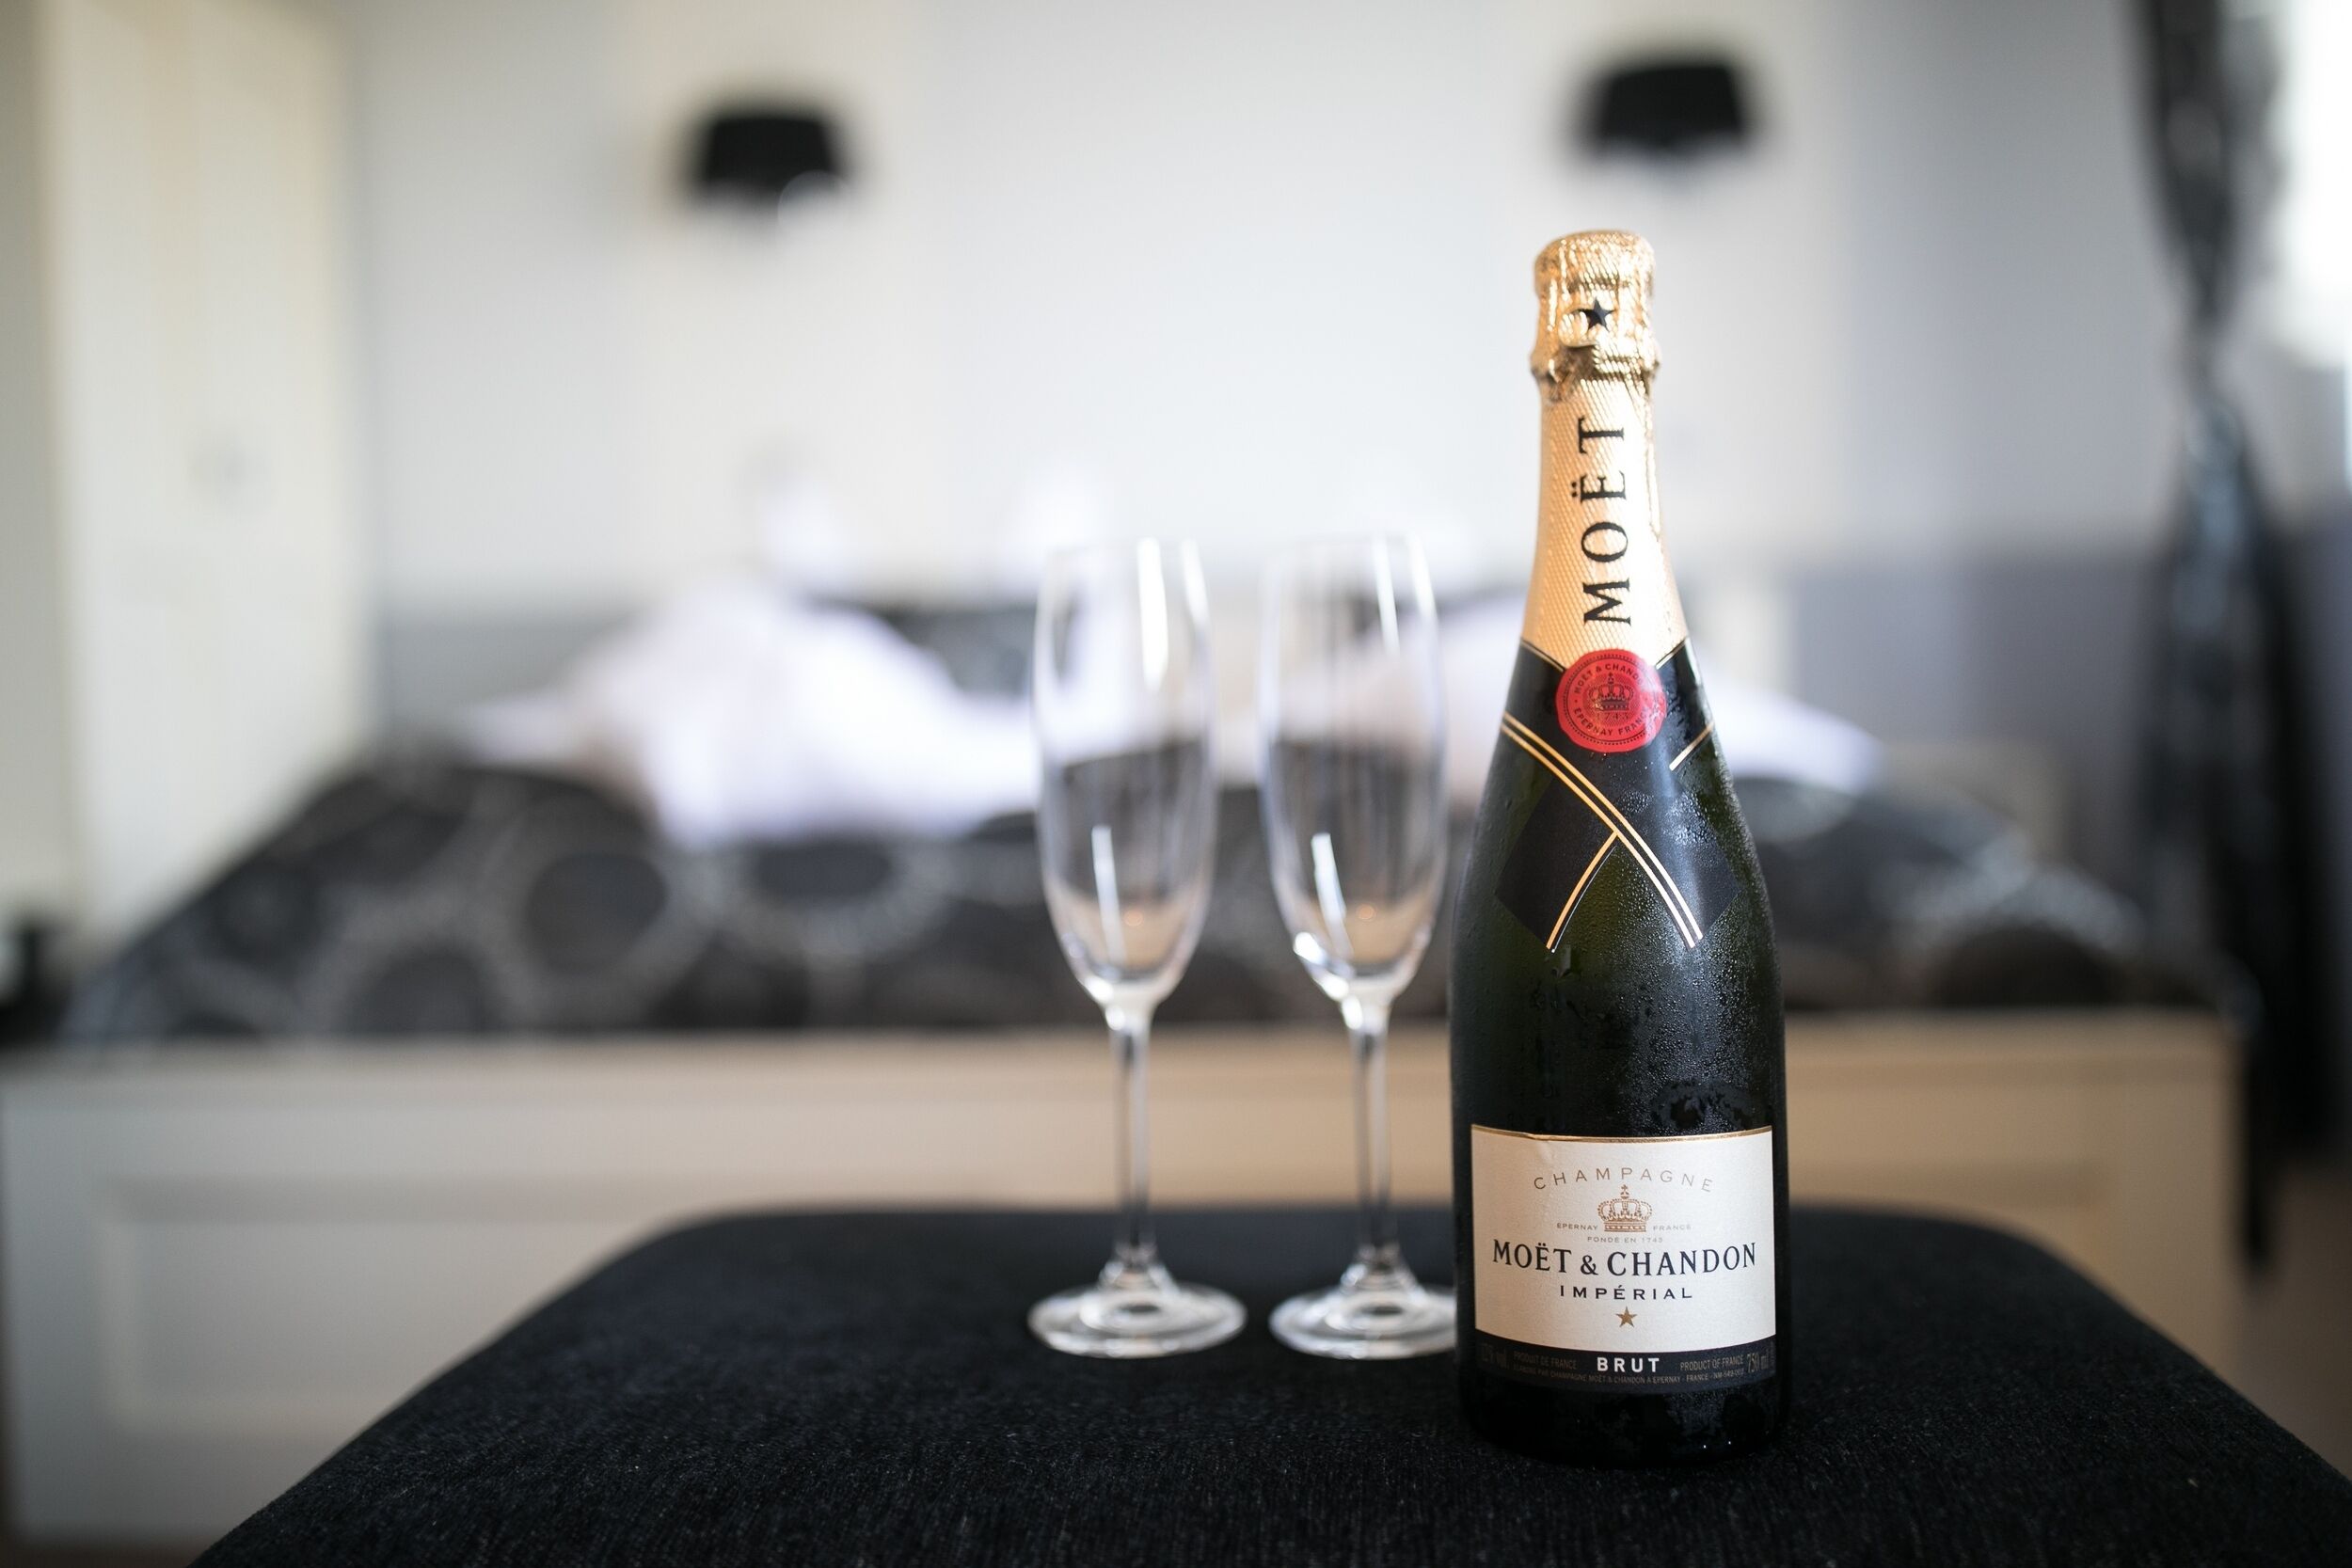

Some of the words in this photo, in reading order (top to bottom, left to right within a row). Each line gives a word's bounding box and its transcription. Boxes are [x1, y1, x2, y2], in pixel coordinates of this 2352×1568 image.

[1572, 417, 1631, 626] MOËT
[1534, 1167, 1713, 1193] CHAMPAGNE
[1492, 1239, 1572, 1274] MOËT
[1580, 1255, 1599, 1275] &
[1607, 1242, 1756, 1276] CHANDON
[1560, 1285, 1692, 1300] IMPÉRIAL
[1597, 1357, 1660, 1373] BRUT
[1679, 1360, 1710, 1371] PRODUCT
[1711, 1358, 1721, 1369] OF
[1721, 1354, 1744, 1368] FRANCE
[1686, 1372, 1708, 1383] FRANCE
